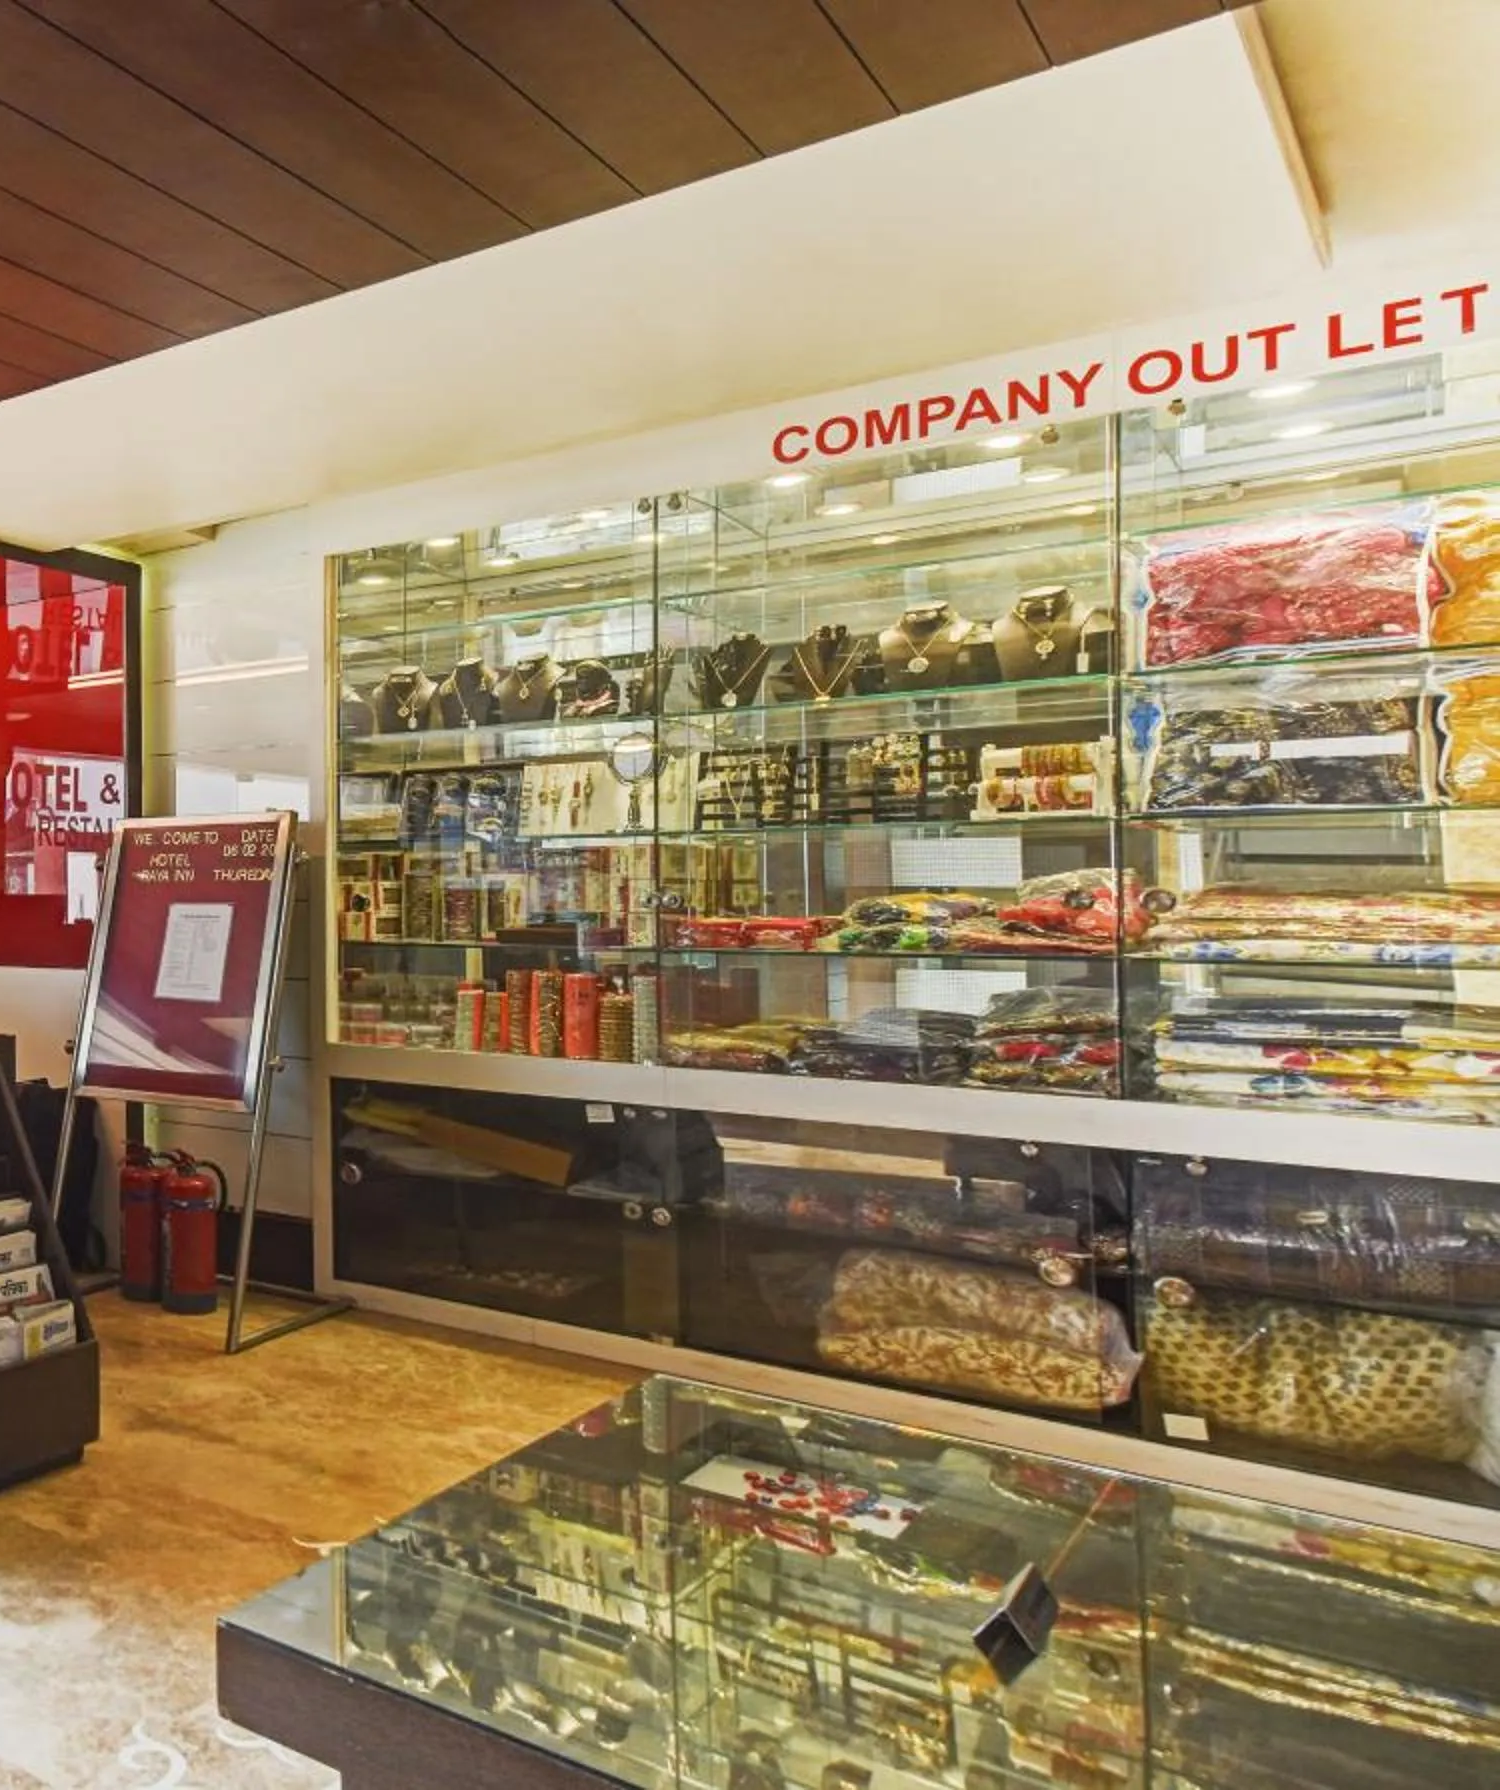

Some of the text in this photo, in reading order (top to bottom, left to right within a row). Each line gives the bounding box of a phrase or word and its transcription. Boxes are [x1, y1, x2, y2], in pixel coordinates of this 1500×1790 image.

[773, 363, 1106, 465] COMPANY
[1127, 322, 1297, 396] OUT
[100, 773, 120, 804] &
[202, 831, 219, 845] TO
[241, 828, 275, 843] DATE
[149, 853, 191, 867] HOTEL
